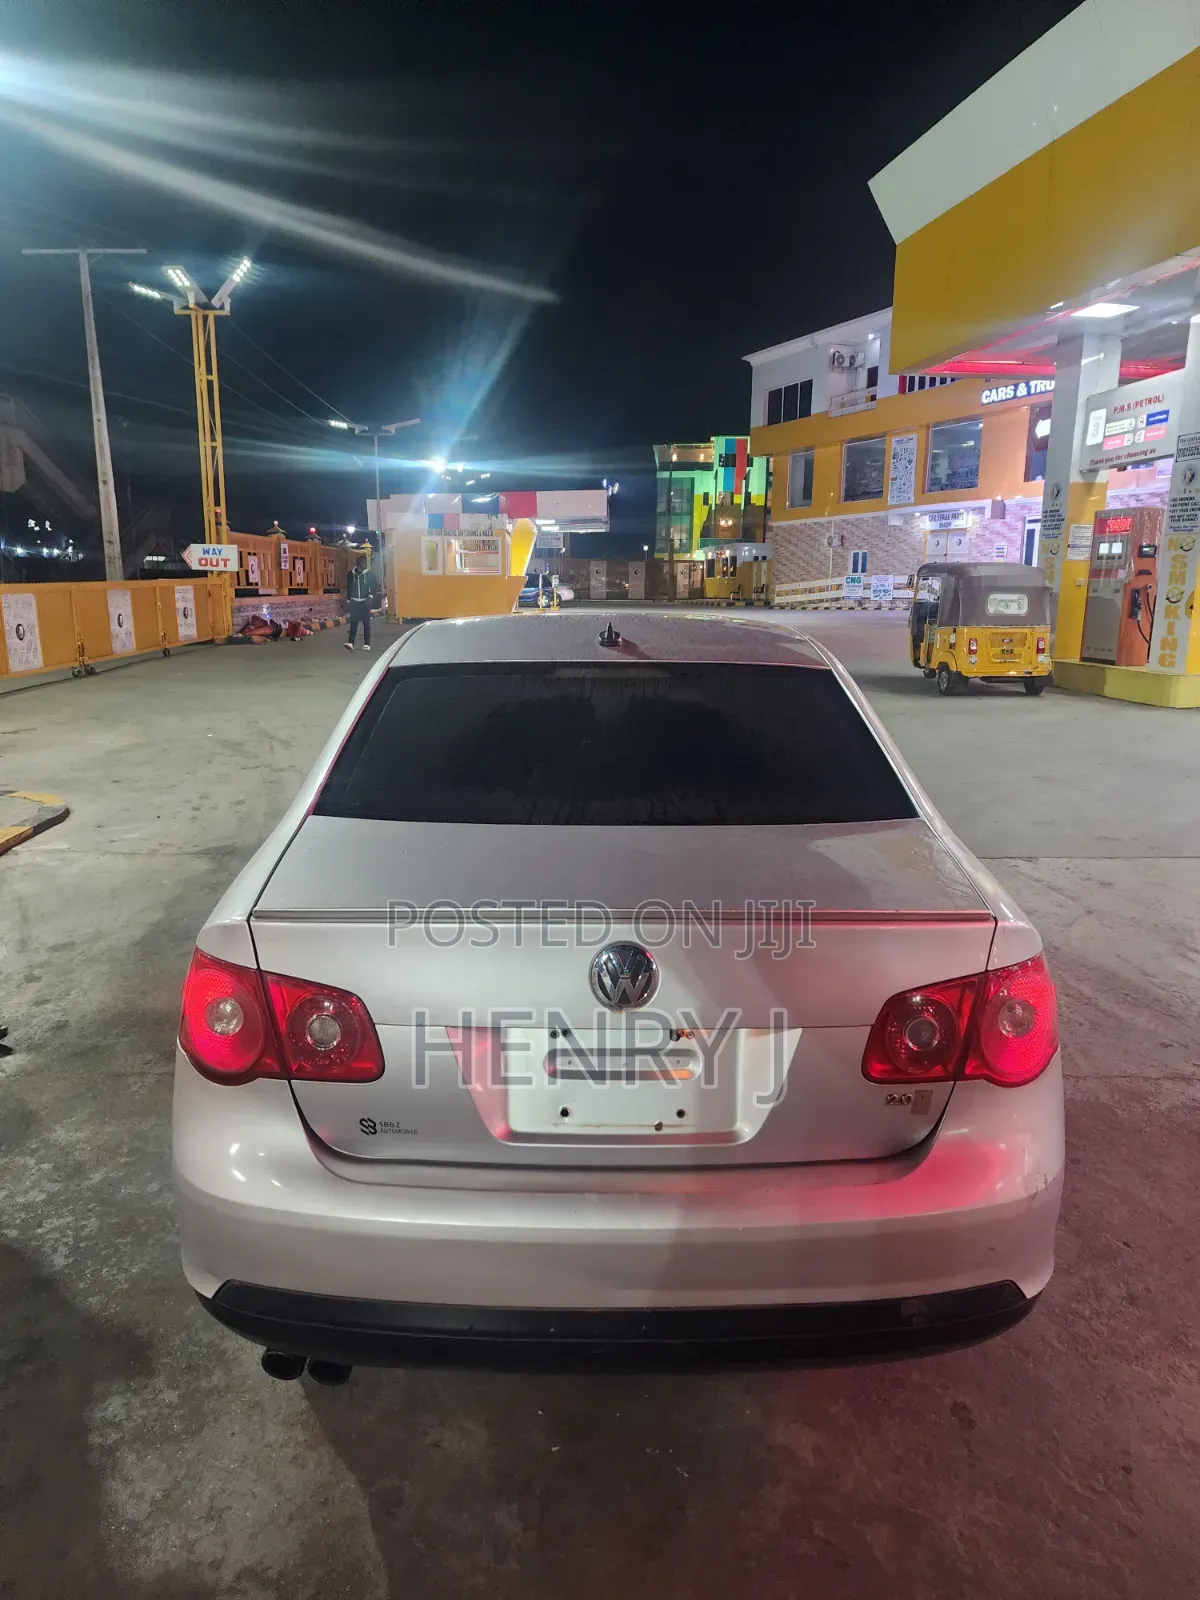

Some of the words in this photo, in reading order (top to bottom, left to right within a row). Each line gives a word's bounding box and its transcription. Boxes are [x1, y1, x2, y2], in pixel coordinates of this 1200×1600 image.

[981, 385, 1015, 405] CARS
[1016, 382, 1028, 397] &
[1113, 402, 1132, 415] P.M.S
[1132, 394, 1165, 411] (PETROL)
[1089, 458, 1105, 466] Thank
[1104, 456, 1114, 464] you
[1114, 453, 1123, 461] for
[1124, 448, 1149, 459] choosing
[202, 547, 223, 556] WAY
[197, 558, 231, 568] OUT
[845, 576, 862, 584] CNG
